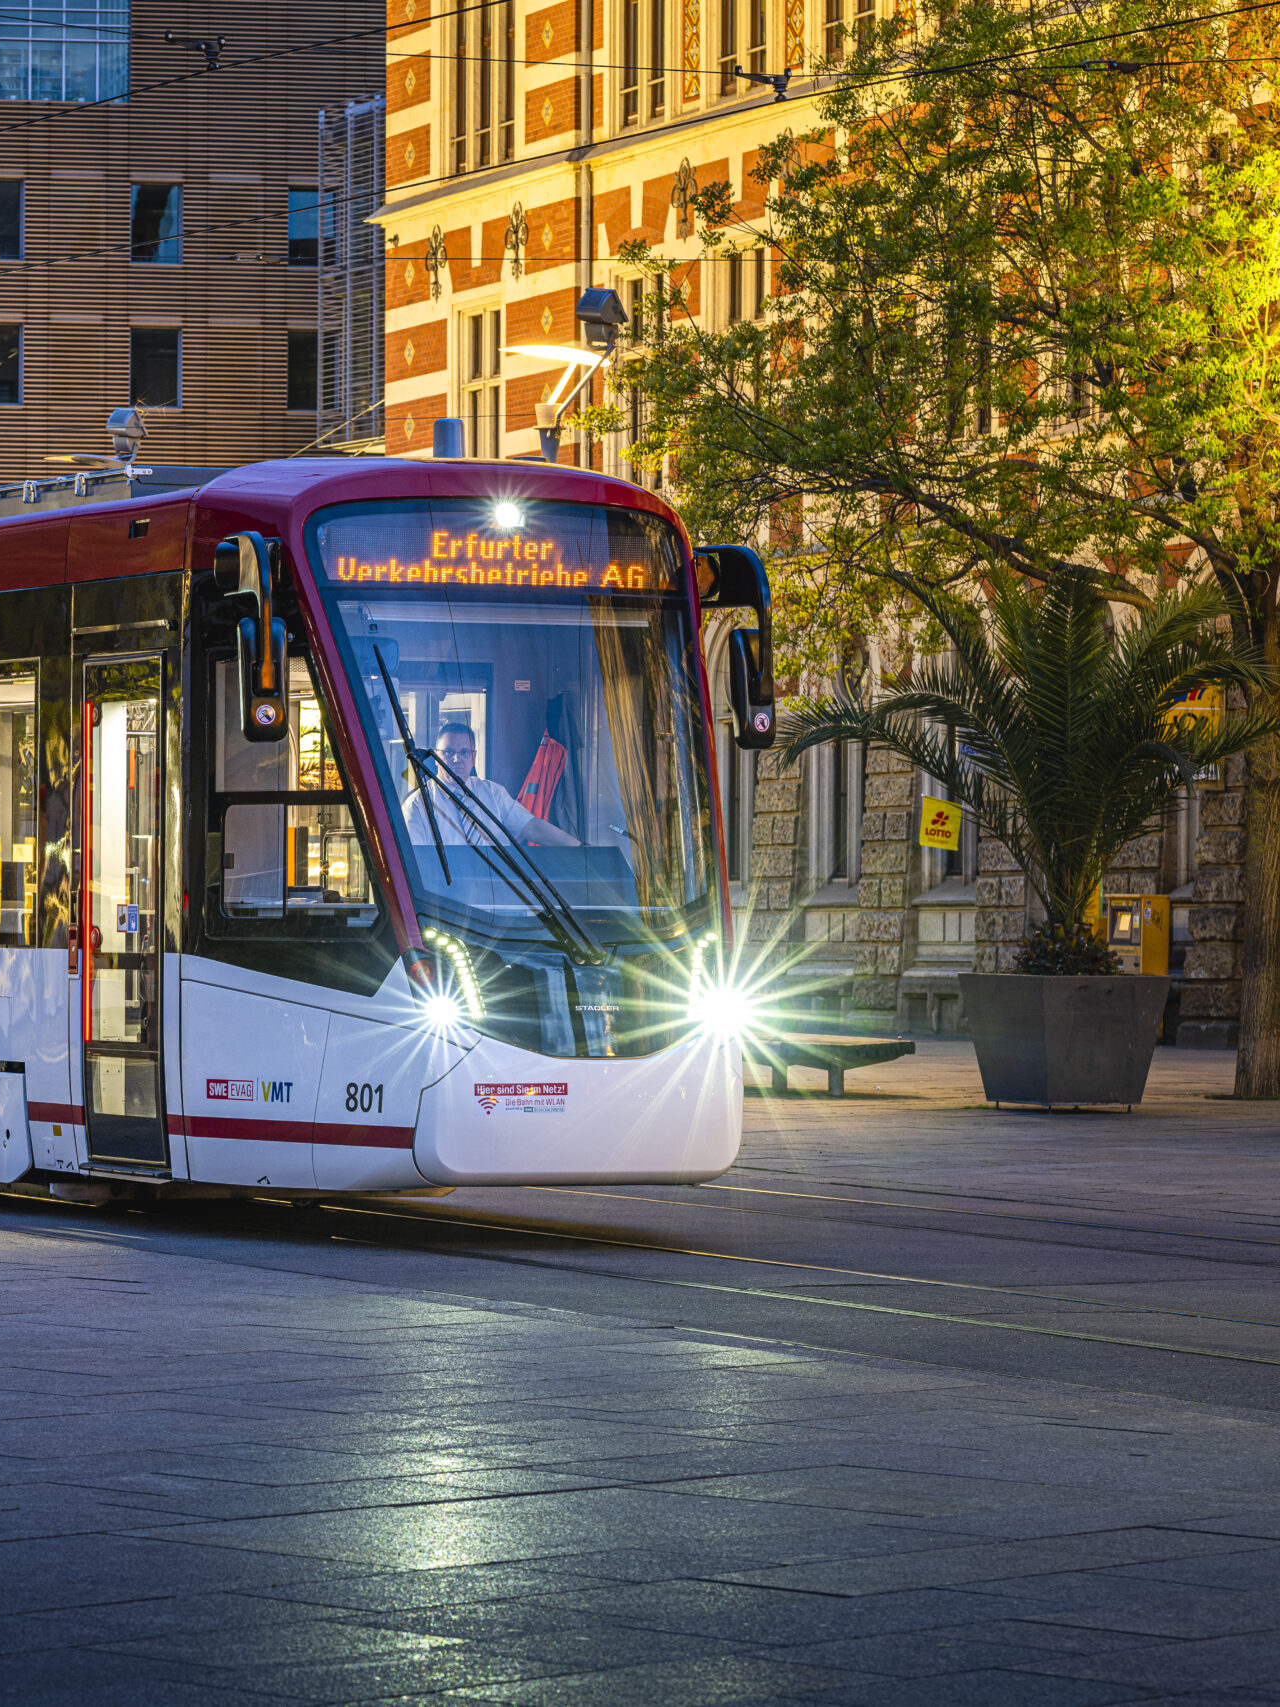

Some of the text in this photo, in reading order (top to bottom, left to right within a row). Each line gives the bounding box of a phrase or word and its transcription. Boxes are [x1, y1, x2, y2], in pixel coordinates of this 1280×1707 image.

[433, 531, 554, 560] Erfurter
[600, 563, 645, 588] AG
[925, 827, 952, 839] LOTTO
[209, 1081, 293, 1103] SWE EVAG VMT
[345, 1082, 384, 1113] 801
[477, 1084, 496, 1095] Hier
[497, 1084, 515, 1094] sind
[516, 1084, 528, 1094] Sie
[544, 1084, 565, 1094] Netz!
[505, 1098, 516, 1106] Die
[517, 1098, 533, 1106] Bahn
[545, 1098, 565, 1106] WLAN
